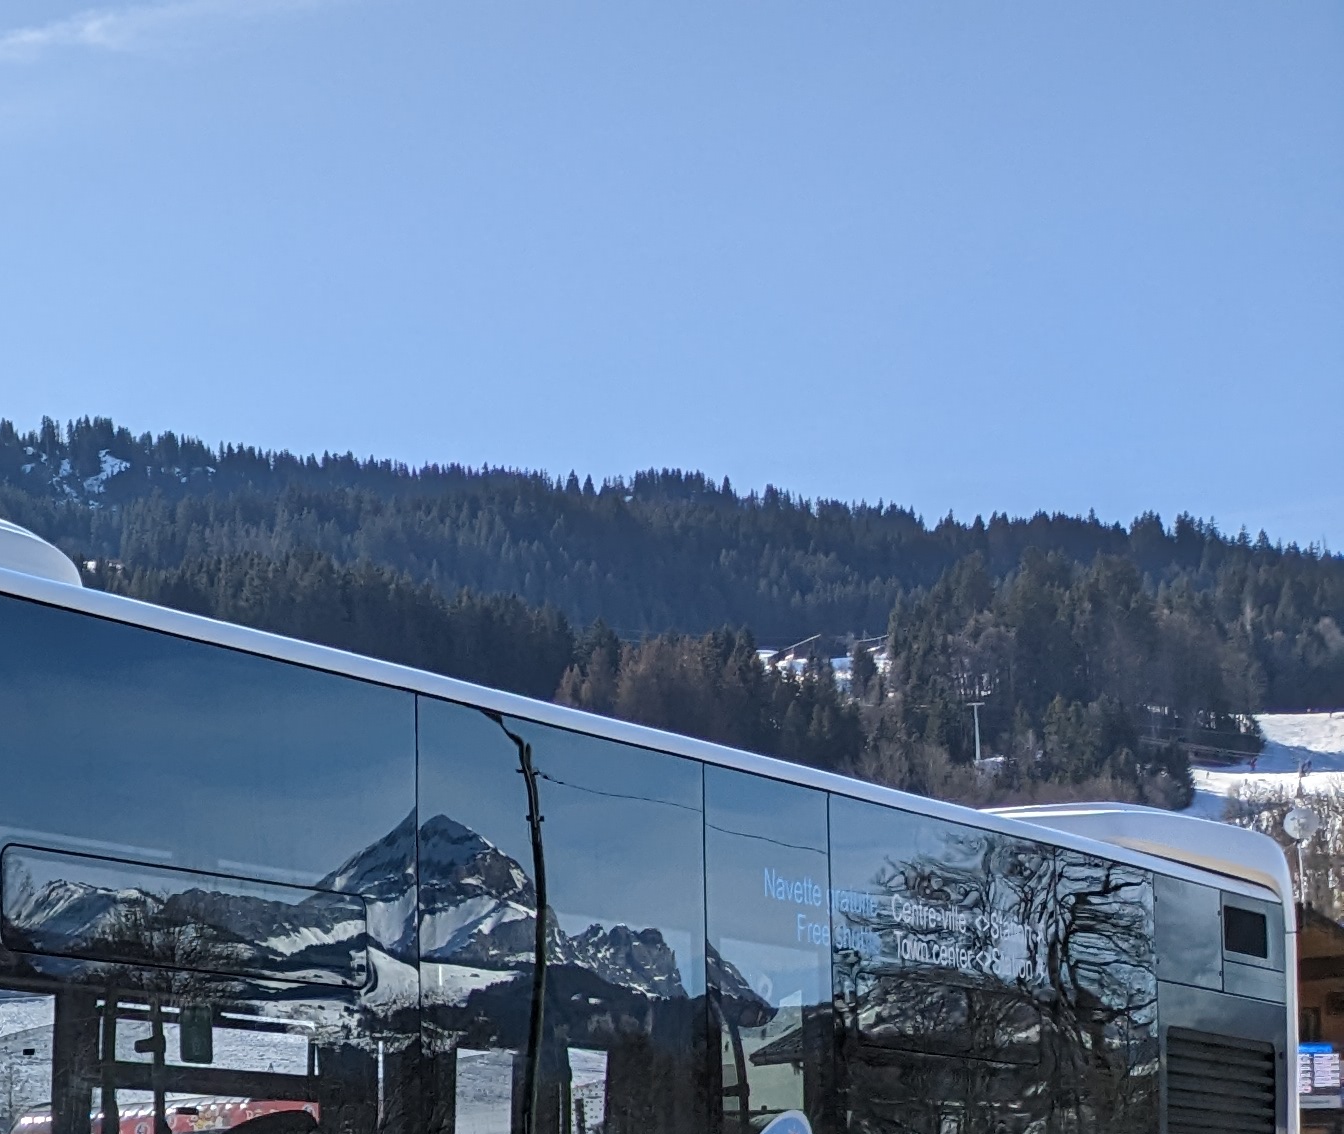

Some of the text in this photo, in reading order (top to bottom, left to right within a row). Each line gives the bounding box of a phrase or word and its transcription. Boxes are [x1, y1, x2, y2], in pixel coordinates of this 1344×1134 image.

[764, 867, 822, 907] Navette
[796, 913, 831, 946] Free
[891, 893, 967, 934] Centre-ville
[893, 930, 929, 961] Town
[932, 944, 972, 969] center
